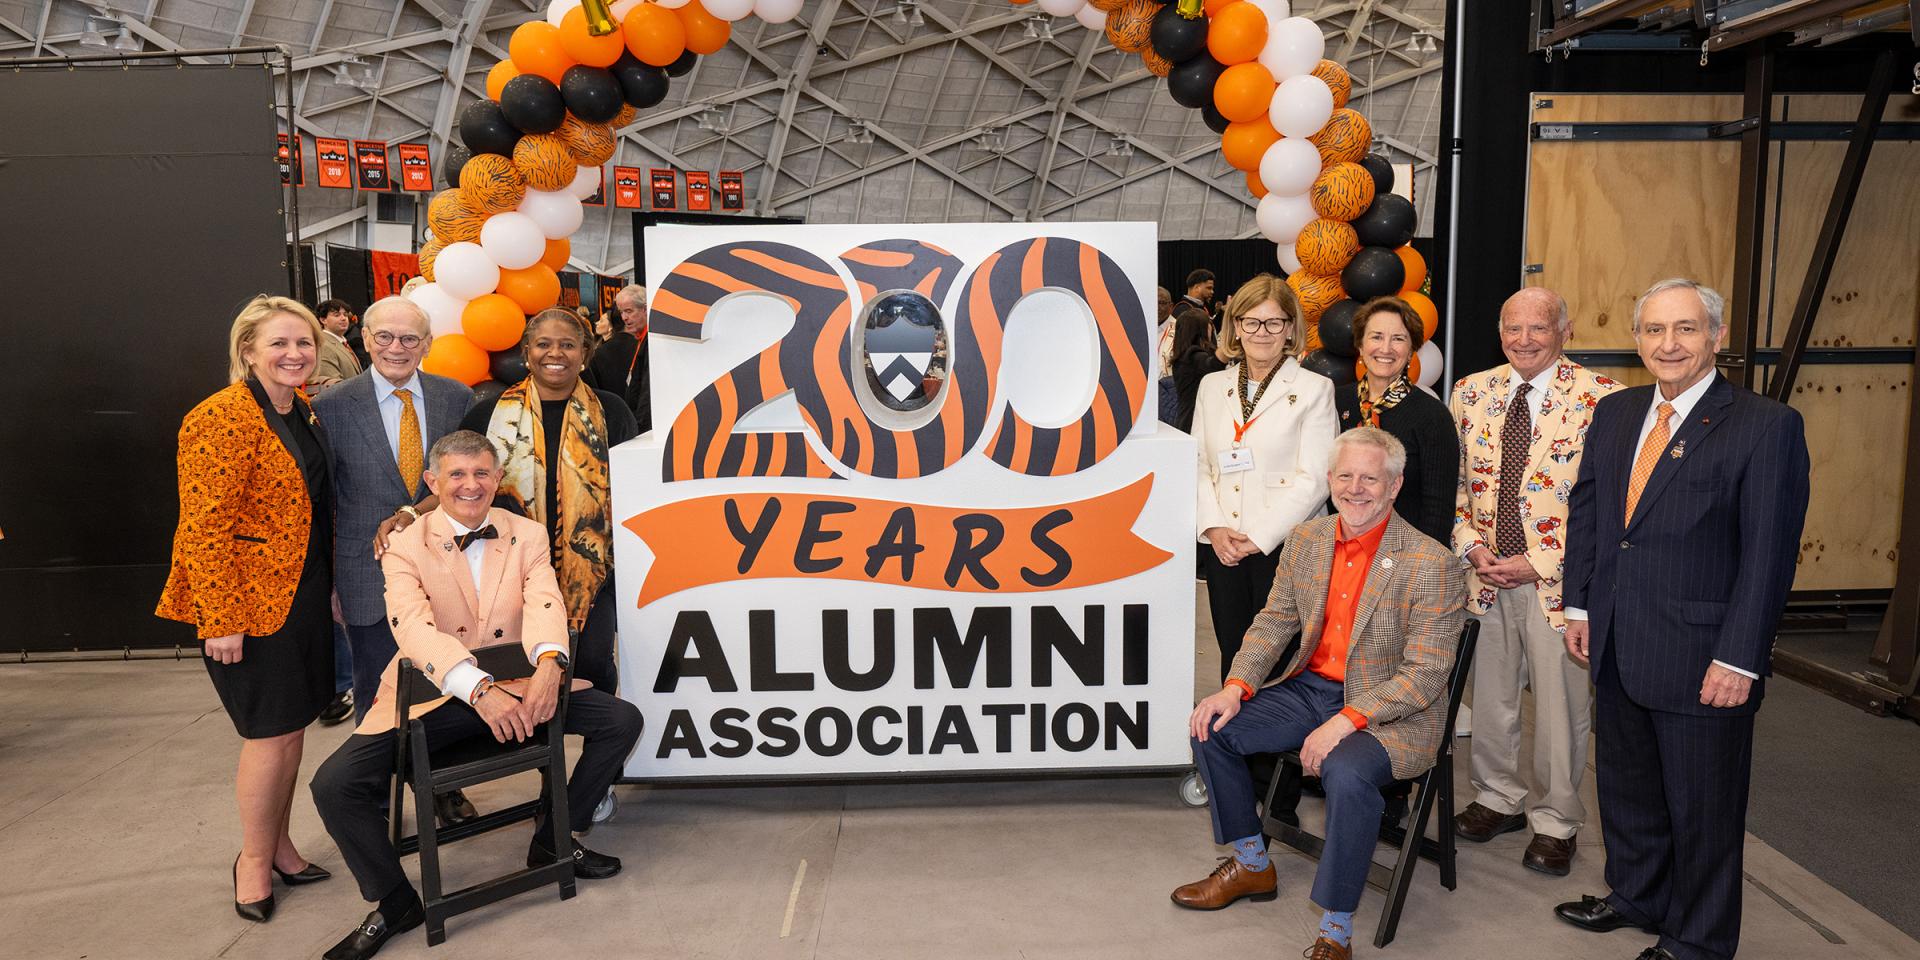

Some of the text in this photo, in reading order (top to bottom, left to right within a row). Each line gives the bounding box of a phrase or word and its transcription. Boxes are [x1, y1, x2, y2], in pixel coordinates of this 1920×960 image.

[367, 170, 381, 178] 2015
[649, 236, 1150, 483] 200
[724, 497, 1073, 590] YEARS
[652, 603, 1149, 693] ALUMNI
[655, 700, 1149, 759] ASSOCIATION
